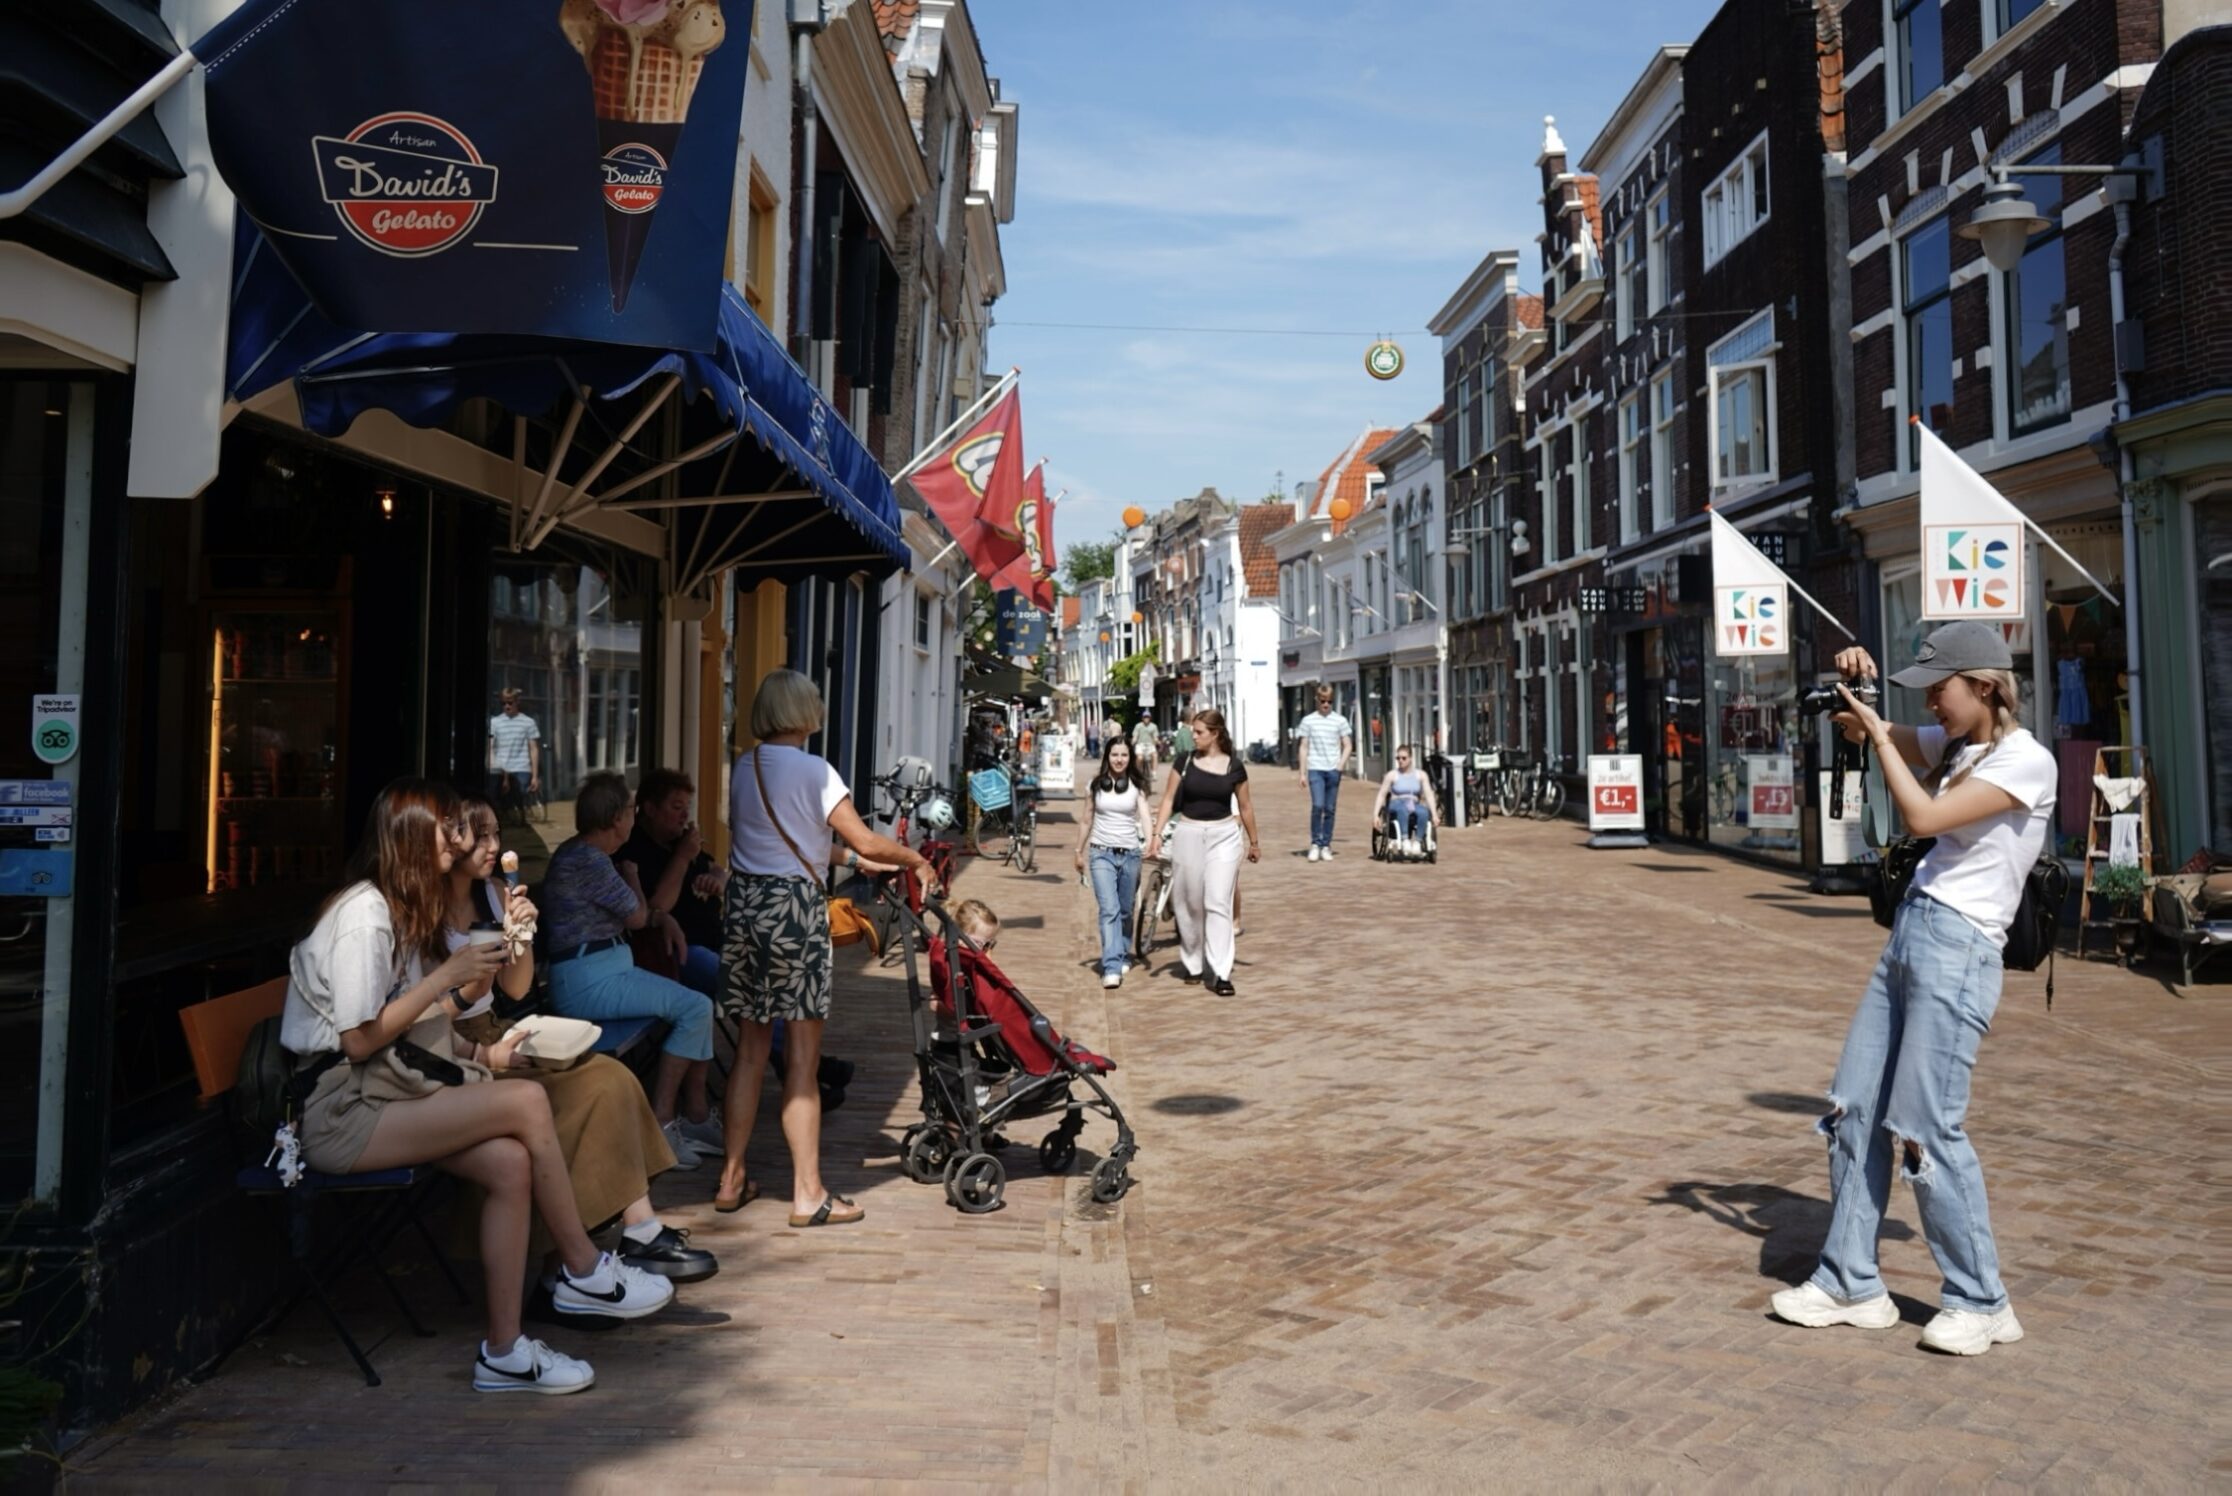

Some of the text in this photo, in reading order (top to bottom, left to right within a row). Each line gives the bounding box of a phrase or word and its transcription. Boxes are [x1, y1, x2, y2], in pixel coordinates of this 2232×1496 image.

[388, 130, 437, 147] Artisan
[334, 156, 472, 197] David's
[600, 164, 663, 185] David's
[614, 188, 655, 201] Gelato
[372, 209, 456, 234] Gelato
[1751, 535, 1784, 545] VAN
[1948, 531, 2009, 571] Kie
[1732, 590, 1776, 620] Kie
[1935, 578, 2009, 609] Wie
[1724, 623, 1777, 648] Wie
[24, 786, 69, 798] facebook
[1600, 788, 1632, 808] €1,-
